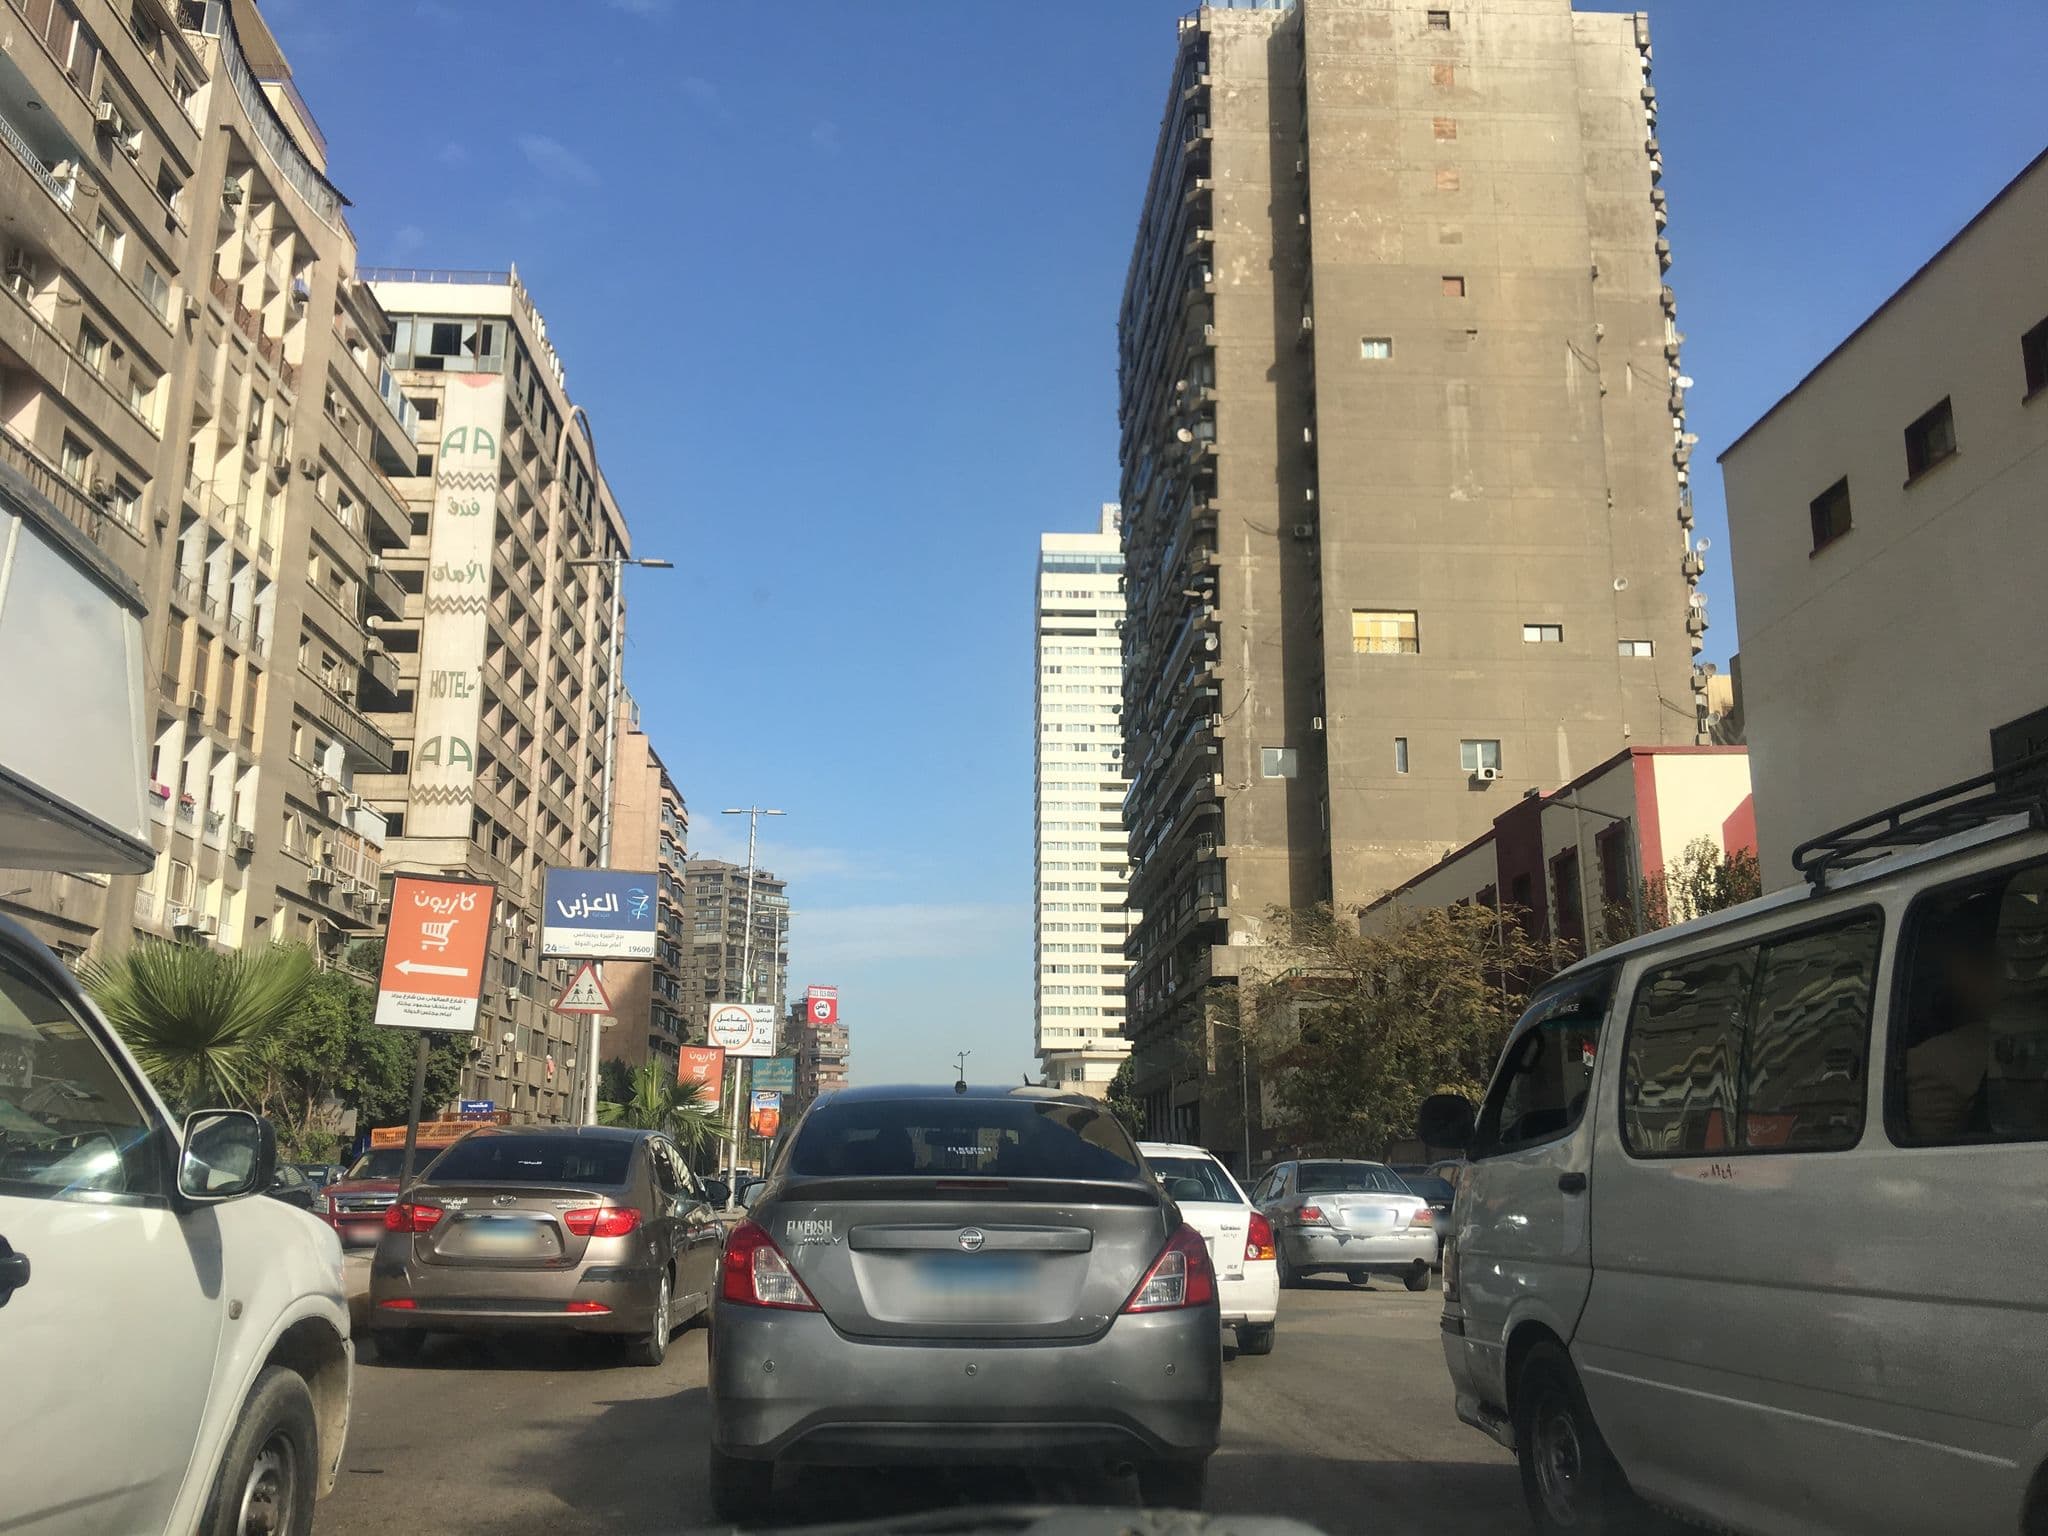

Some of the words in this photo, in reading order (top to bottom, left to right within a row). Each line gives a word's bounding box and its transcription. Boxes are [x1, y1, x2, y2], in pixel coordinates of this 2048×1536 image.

[430, 669, 470, 699] HOTEL
[413, 890, 477, 914] كازيون
[544, 944, 558, 953] 24
[689, 1051, 717, 1062] كازيون
